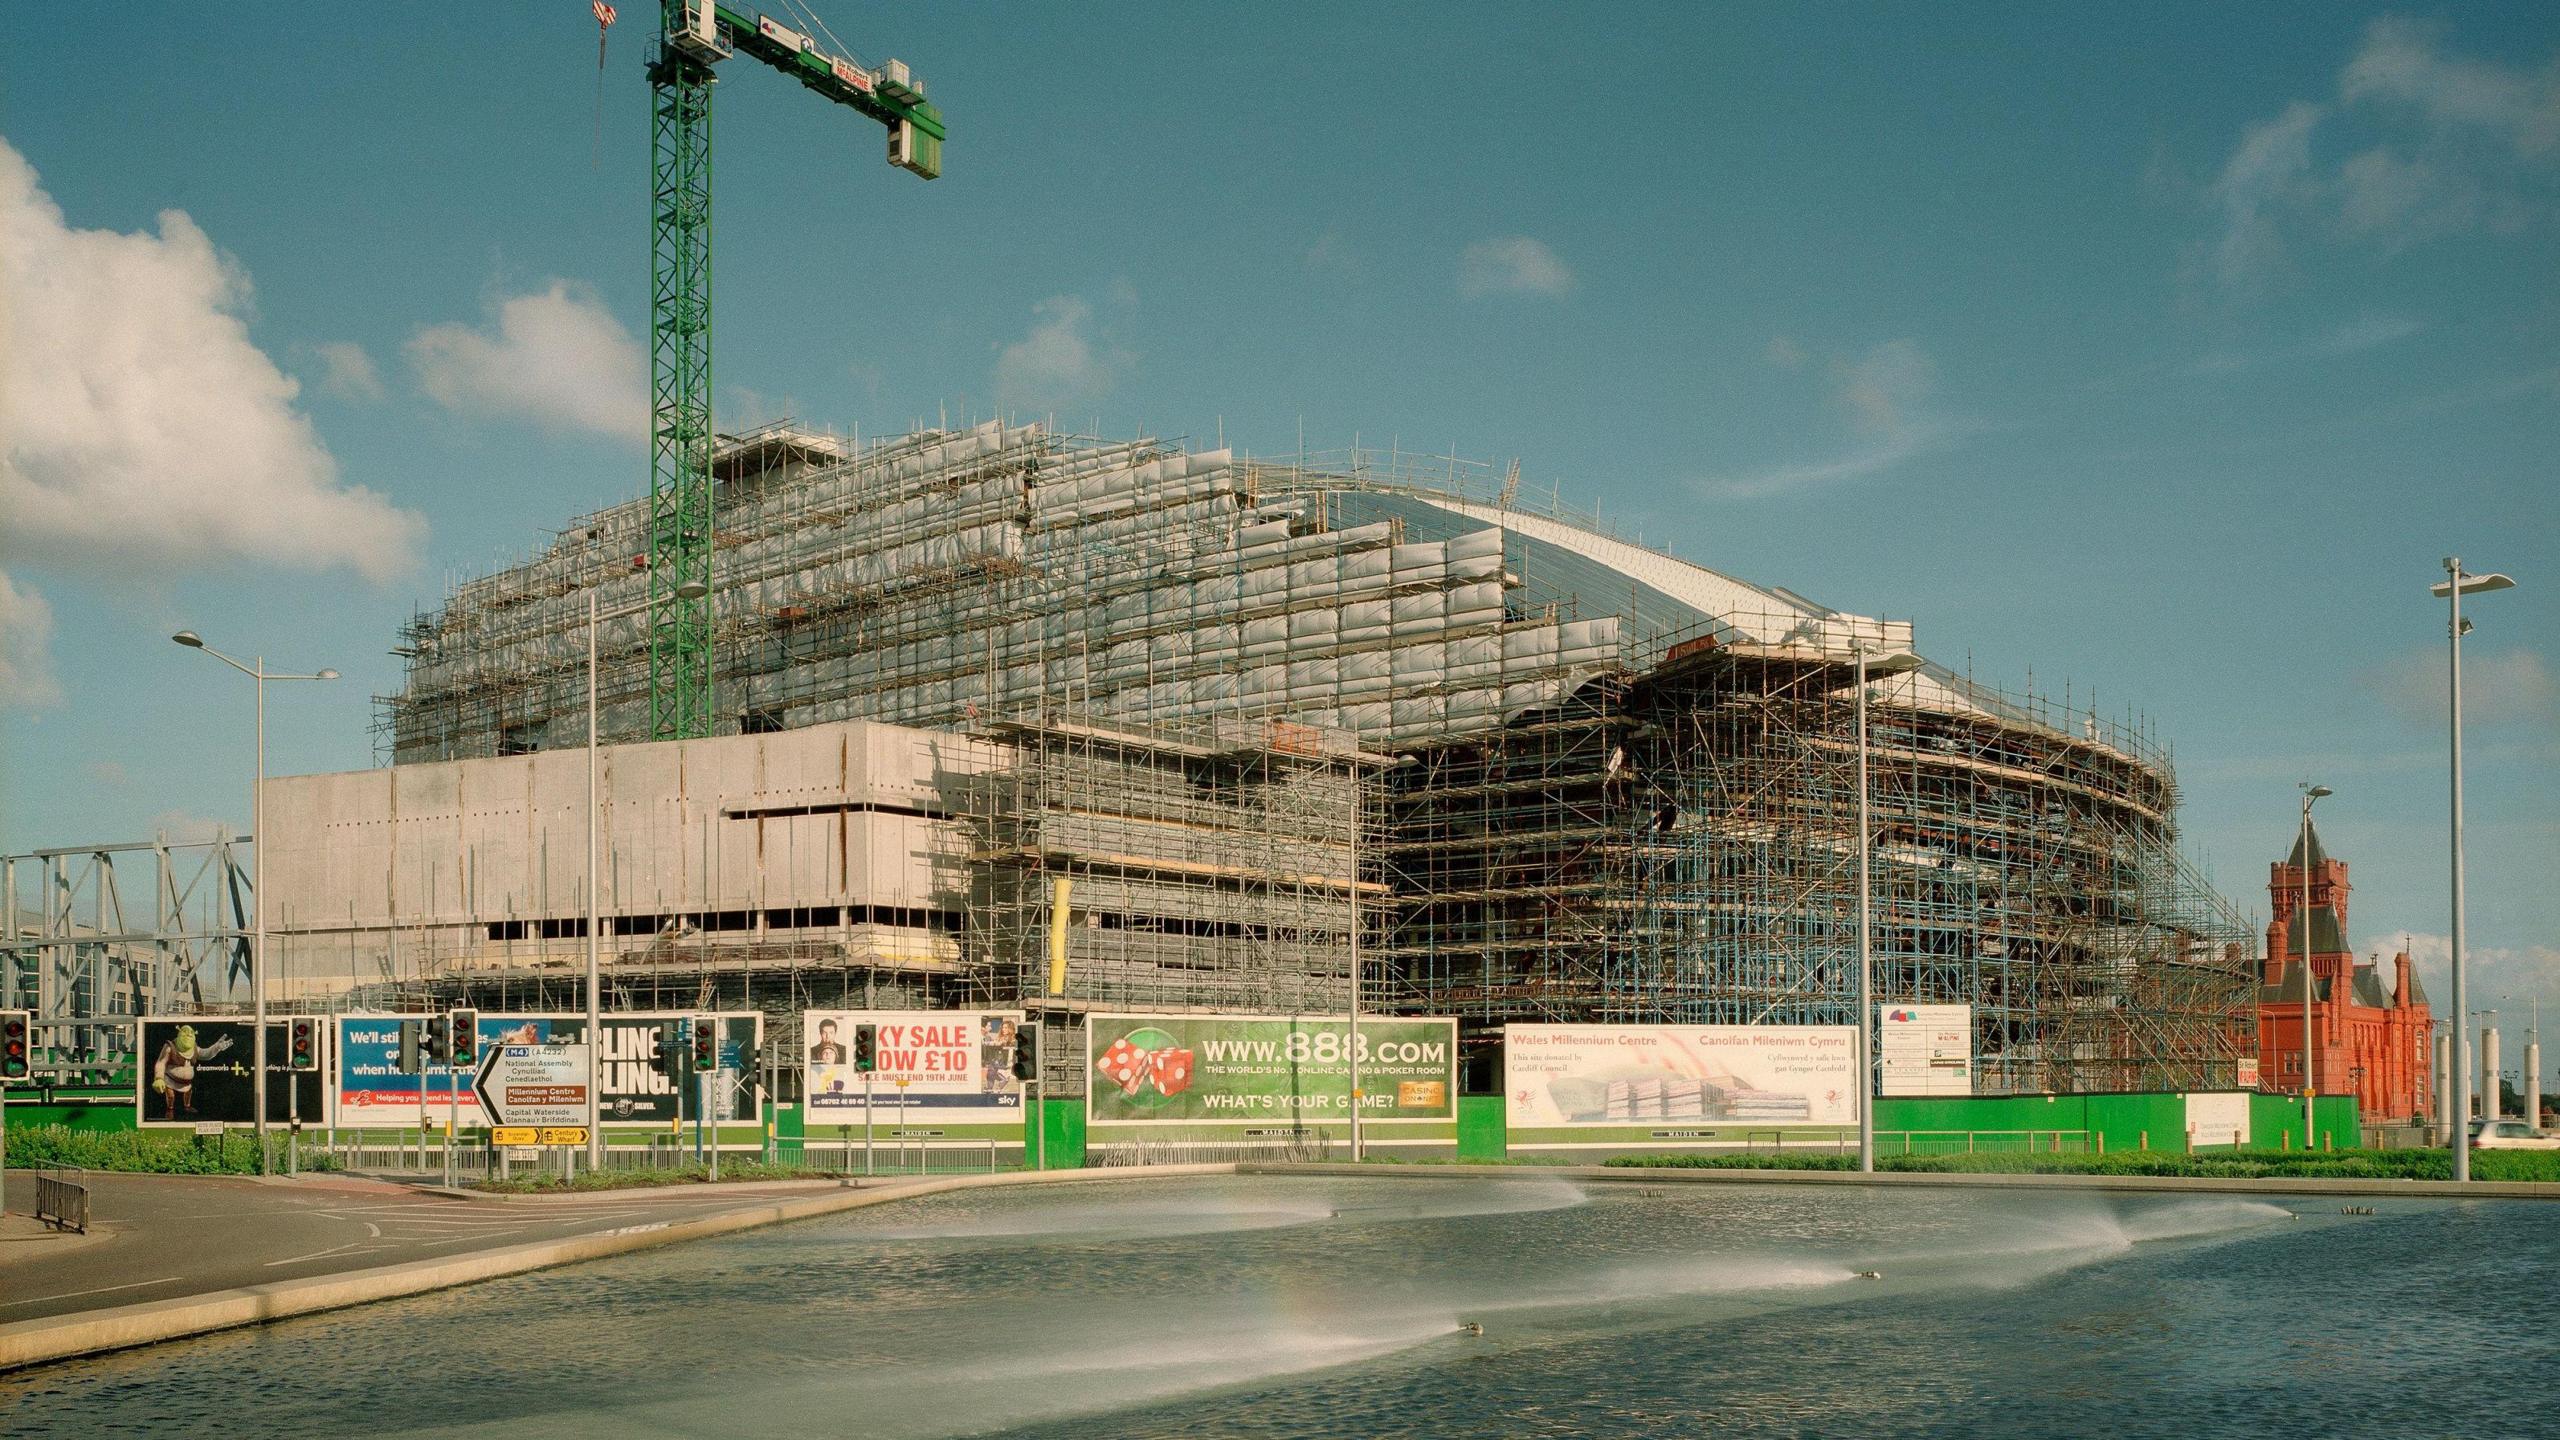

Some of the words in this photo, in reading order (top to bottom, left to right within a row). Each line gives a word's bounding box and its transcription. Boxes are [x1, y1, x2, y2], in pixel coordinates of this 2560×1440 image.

[350, 1032, 378, 1044] We'll
[878, 1026, 905, 1047] KY
[910, 1026, 972, 1048] SALE.
[1512, 1034, 1548, 1045] Wales
[1552, 1034, 1615, 1046] Millennium
[1618, 1035, 1657, 1046] Centre
[1700, 1035, 1749, 1046] Canolfan
[1753, 1036, 1805, 1046] Mileniwm
[1809, 1036, 1846, 1048] Cymru
[506, 1048, 529, 1057] (M4)
[532, 1048, 567, 1056] (A4232)
[1203, 1032, 1446, 1063] WWW.888.COM
[878, 1050, 916, 1071] OW
[925, 1050, 967, 1071] £10
[1512, 1053, 1528, 1061] This
[538, 1060, 573, 1068] Assembly
[1540, 1063, 1568, 1072] Council
[352, 1064, 384, 1075] when
[1205, 1066, 1225, 1074] THE
[1227, 1066, 1272, 1074] WORLD'S
[1336, 1067, 1372, 1075] CANO
[1382, 1067, 1415, 1075] POKER
[1416, 1067, 1445, 1075] ROOM
[598, 1061, 678, 1095] LING.
[948, 1074, 968, 1082] JUNE
[1403, 1087, 1440, 1095] CASINO
[376, 1094, 402, 1103] Helping
[406, 1095, 420, 1103] you
[998, 1095, 1016, 1106] sky
[1203, 1094, 1274, 1108] WHAT'S
[1279, 1095, 1329, 1108] YOUR
[506, 1109, 532, 1117] Capital
[555, 1130, 578, 1139] Century
